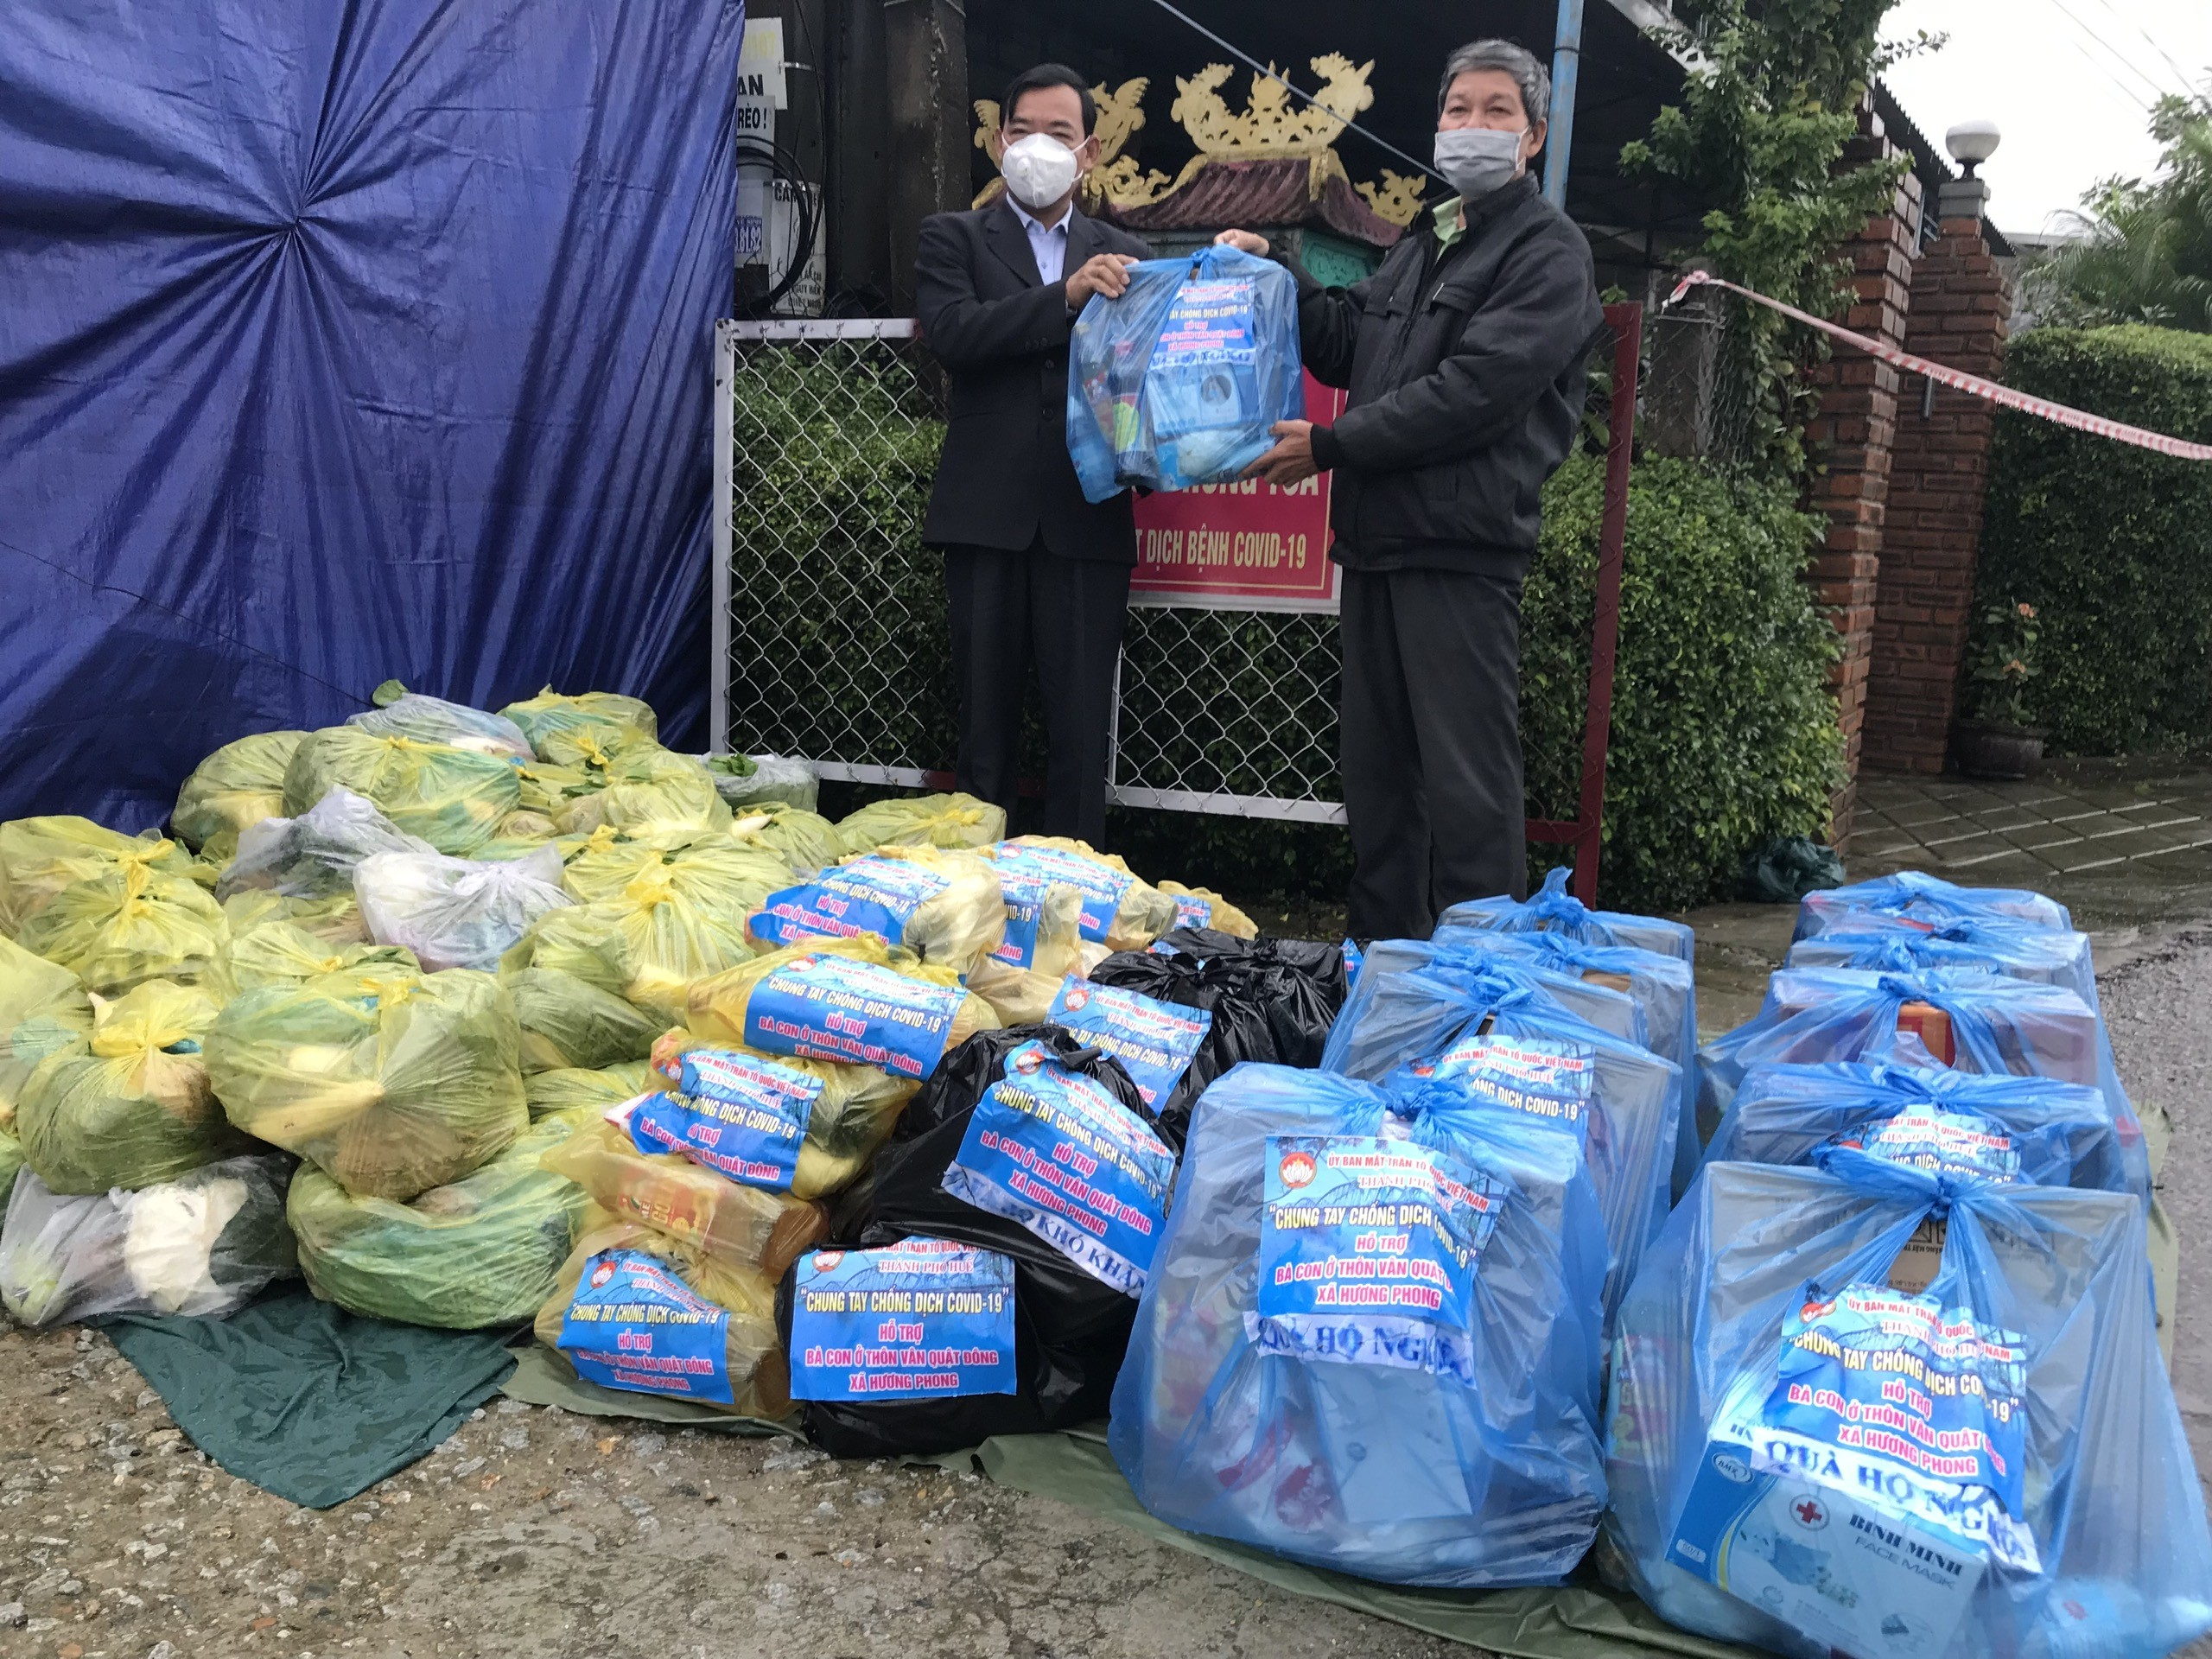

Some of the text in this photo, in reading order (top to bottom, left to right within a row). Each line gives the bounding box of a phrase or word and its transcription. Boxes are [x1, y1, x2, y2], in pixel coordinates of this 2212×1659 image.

[1147, 522, 1307, 574] DỊCH BỆNH COVID-19
[823, 918, 840, 934] VÂN
[768, 975, 806, 997] “CHUNG
[807, 988, 827, 1001] TAY
[828, 990, 862, 1012] CHỐNG
[865, 1001, 891, 1020] DỊCH
[892, 1008, 950, 1033] COVID-19”
[826, 1013, 866, 1039] HỖ TRỢ
[1186, 1024, 1202, 1033] NAM
[760, 1016, 774, 1033] BÀ
[777, 1022, 798, 1038] CON
[802, 1024, 811, 1041] Ở
[810, 1030, 839, 1048] THÔN
[842, 1038, 863, 1056] VÂN
[865, 1046, 892, 1064] QUẬT
[893, 1056, 922, 1075] ĐÔNG
[1119, 1041, 1143, 1061] DỊCH
[1522, 1052, 1542, 1065] QUỐC
[1563, 1062, 1583, 1071] NAM
[791, 1089, 809, 1099] NAM
[719, 1103, 747, 1125] DỊCH
[1525, 1096, 1586, 1122] COVID-19”
[700, 1128, 721, 1147] TRỢ
[1037, 1099, 1118, 1160] TAY CHỐNG DỊCH
[1149, 1141, 1166, 1156] NAM
[1987, 1138, 2009, 1149] NAM
[719, 1158, 746, 1175] QUẬT
[747, 1166, 779, 1180] ĐÔNG
[1053, 1142, 1096, 1178] HỖ TRỢ
[982, 1132, 1150, 1233] BÀ CON Ở THÔN VÂN QUẬT ĐÔNG
[1329, 1154, 1488, 1211] ỦY BAN MẶT VIỆT NAM
[1011, 1171, 1028, 1190] XÃ
[1028, 1185, 1065, 1211] HƯƠNG
[1067, 1205, 1106, 1236] PHONG
[1269, 1205, 1319, 1229] “CHUNG
[1324, 1207, 1346, 1224] TAY
[1349, 1201, 1395, 1225] CHỐNG
[1400, 1205, 1432, 1229] DỊCH
[1037, 1215, 1084, 1253] KHÓ
[1357, 1233, 1407, 1253] HỖ TRỢ
[880, 1257, 974, 1272] THÀNH PHỐ HUẾ
[1276, 1266, 1291, 1283] BÀ
[1296, 1263, 1321, 1278] CON
[1325, 1257, 1335, 1276] Ở
[1340, 1258, 1375, 1275] THÔN
[1380, 1258, 1406, 1275] VÂN
[801, 1285, 1009, 1318] “CHUNG TAY CHỐNG DỊCH COVID-19”
[1318, 1285, 1440, 1308] XÃ HƯƠNG PHONG
[601, 1306, 616, 1321] TAY
[616, 1300, 645, 1323] CHỐNG
[647, 1306, 669, 1326] DỊCH
[620, 1330, 652, 1352] HỖ TRỢ
[880, 1319, 923, 1342] HỖ TRỢ
[1865, 1302, 1885, 1311] BAN
[1946, 1325, 1973, 1337] QUỐC
[1986, 1346, 2010, 1359] NAM
[659, 1357, 683, 1374] QUẬT
[685, 1357, 714, 1374] ĐÔNG
[806, 1344, 998, 1367] BÀ CON Ở THÔN VÂN QUẬT ĐÔNG
[1843, 1348, 1867, 1370] TAY
[1872, 1346, 1923, 1382] CHỐNG
[851, 1373, 958, 1390] XÃ HƯƠNG PHONG
[1884, 1381, 1931, 1418] HỖ TRỢ
[1789, 1385, 1980, 1450] BÀ CON Ở THÔN VÂN QUẬT
[1840, 1427, 1976, 1474] XÃ HƯƠNG PHONG
[1766, 1441, 1913, 1503] QUÀ HỘ
[1855, 1536, 1955, 1590] FACE MASK
[1905, 1541, 1962, 1576] MINH
